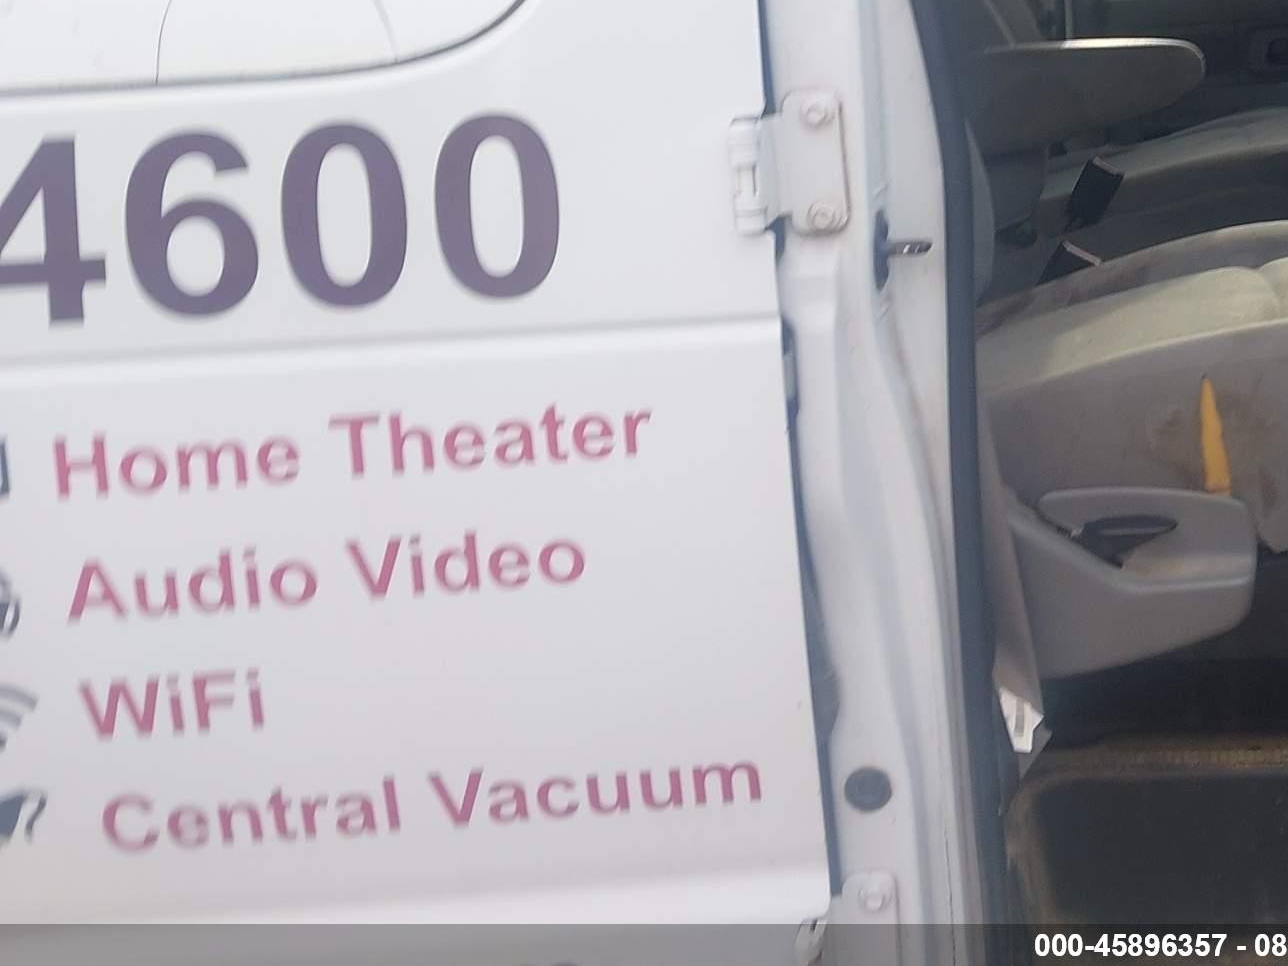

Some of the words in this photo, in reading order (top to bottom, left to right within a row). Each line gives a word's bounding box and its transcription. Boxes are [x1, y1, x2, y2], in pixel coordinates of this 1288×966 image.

[0, 111, 560, 327] 4600
[52, 424, 301, 500] Home
[330, 404, 651, 478] Theater
[67, 546, 319, 620] Audio
[346, 531, 587, 600] Video
[80, 669, 266, 740] WiFi
[101, 777, 401, 851] Central
[430, 761, 763, 827] Vacuum
